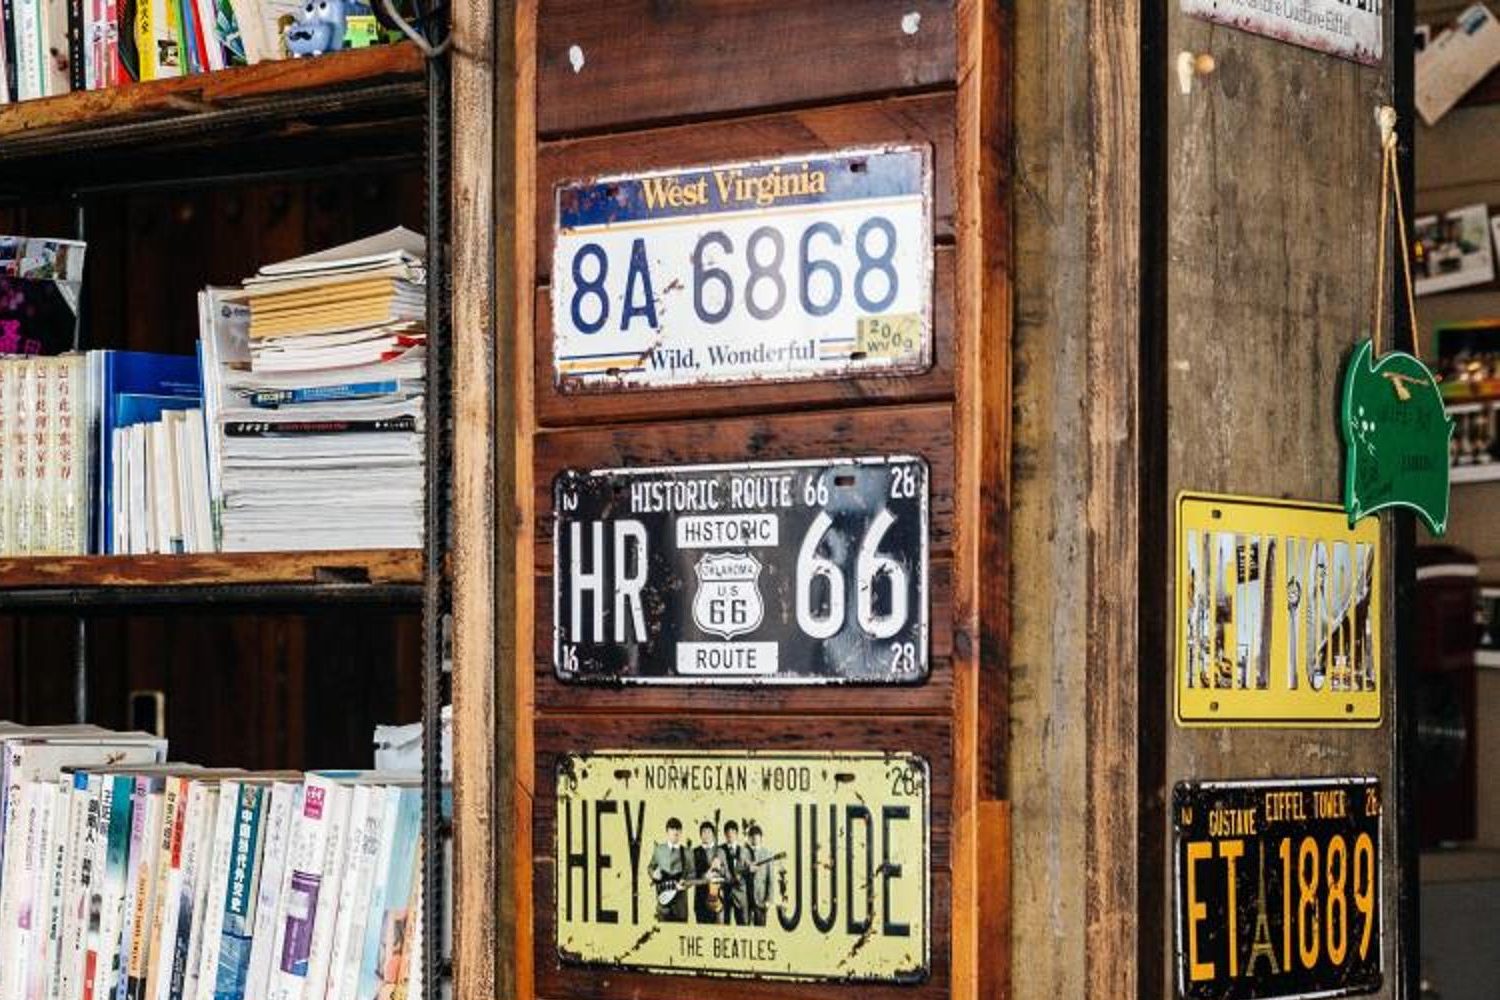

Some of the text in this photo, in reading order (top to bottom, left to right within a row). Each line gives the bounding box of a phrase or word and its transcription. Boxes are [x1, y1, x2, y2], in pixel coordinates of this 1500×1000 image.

[641, 161, 827, 210] West Virginia
[570, 216, 899, 334] 8A 6868
[650, 339, 816, 373] Wild, Wonderful
[631, 474, 829, 512] HISTORIC ROUTE 66
[891, 467, 915, 499] 28
[684, 518, 771, 542] HISTORIC
[570, 519, 648, 643] HR
[701, 562, 754, 577] OKLAHOMA
[795, 508, 908, 640] 66
[708, 599, 748, 625] 66
[1186, 529, 1376, 693] NEW YORK
[695, 647, 758, 670] ROUTE
[890, 642, 916, 674] 28
[644, 764, 812, 793] NORWEGIAN WOOD
[890, 766, 917, 797] 28
[1208, 808, 1258, 837] GUSTAVE
[1265, 791, 1306, 821] EIFFEL
[1313, 789, 1347, 819] TOWER
[565, 799, 912, 937] HEY JUDE
[1187, 831, 1375, 982] ET 1889
[678, 935, 778, 961] THE BEATLES
